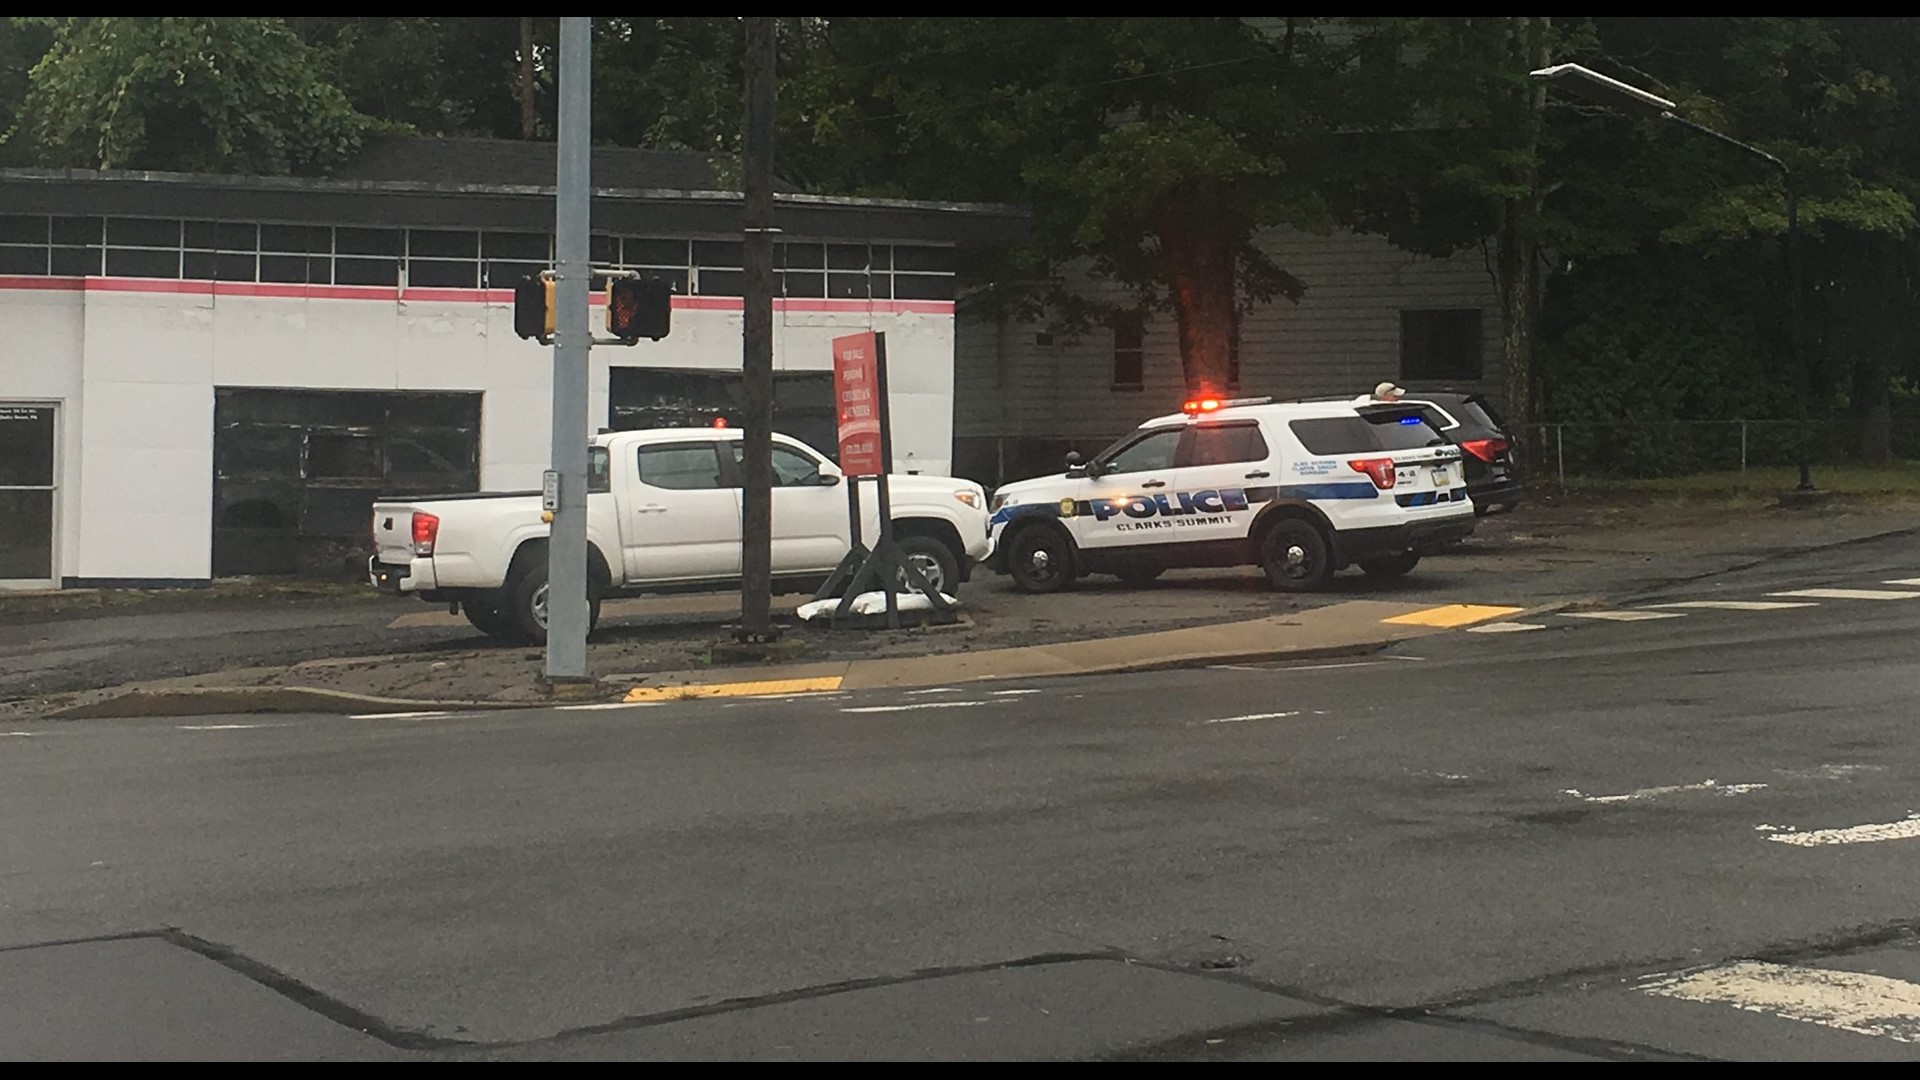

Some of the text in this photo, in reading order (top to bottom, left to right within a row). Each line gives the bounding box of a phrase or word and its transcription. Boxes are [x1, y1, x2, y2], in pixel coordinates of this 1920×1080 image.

[1089, 488, 1249, 521] POLICE
[1116, 515, 1233, 531] CLARKS SUMMIT
